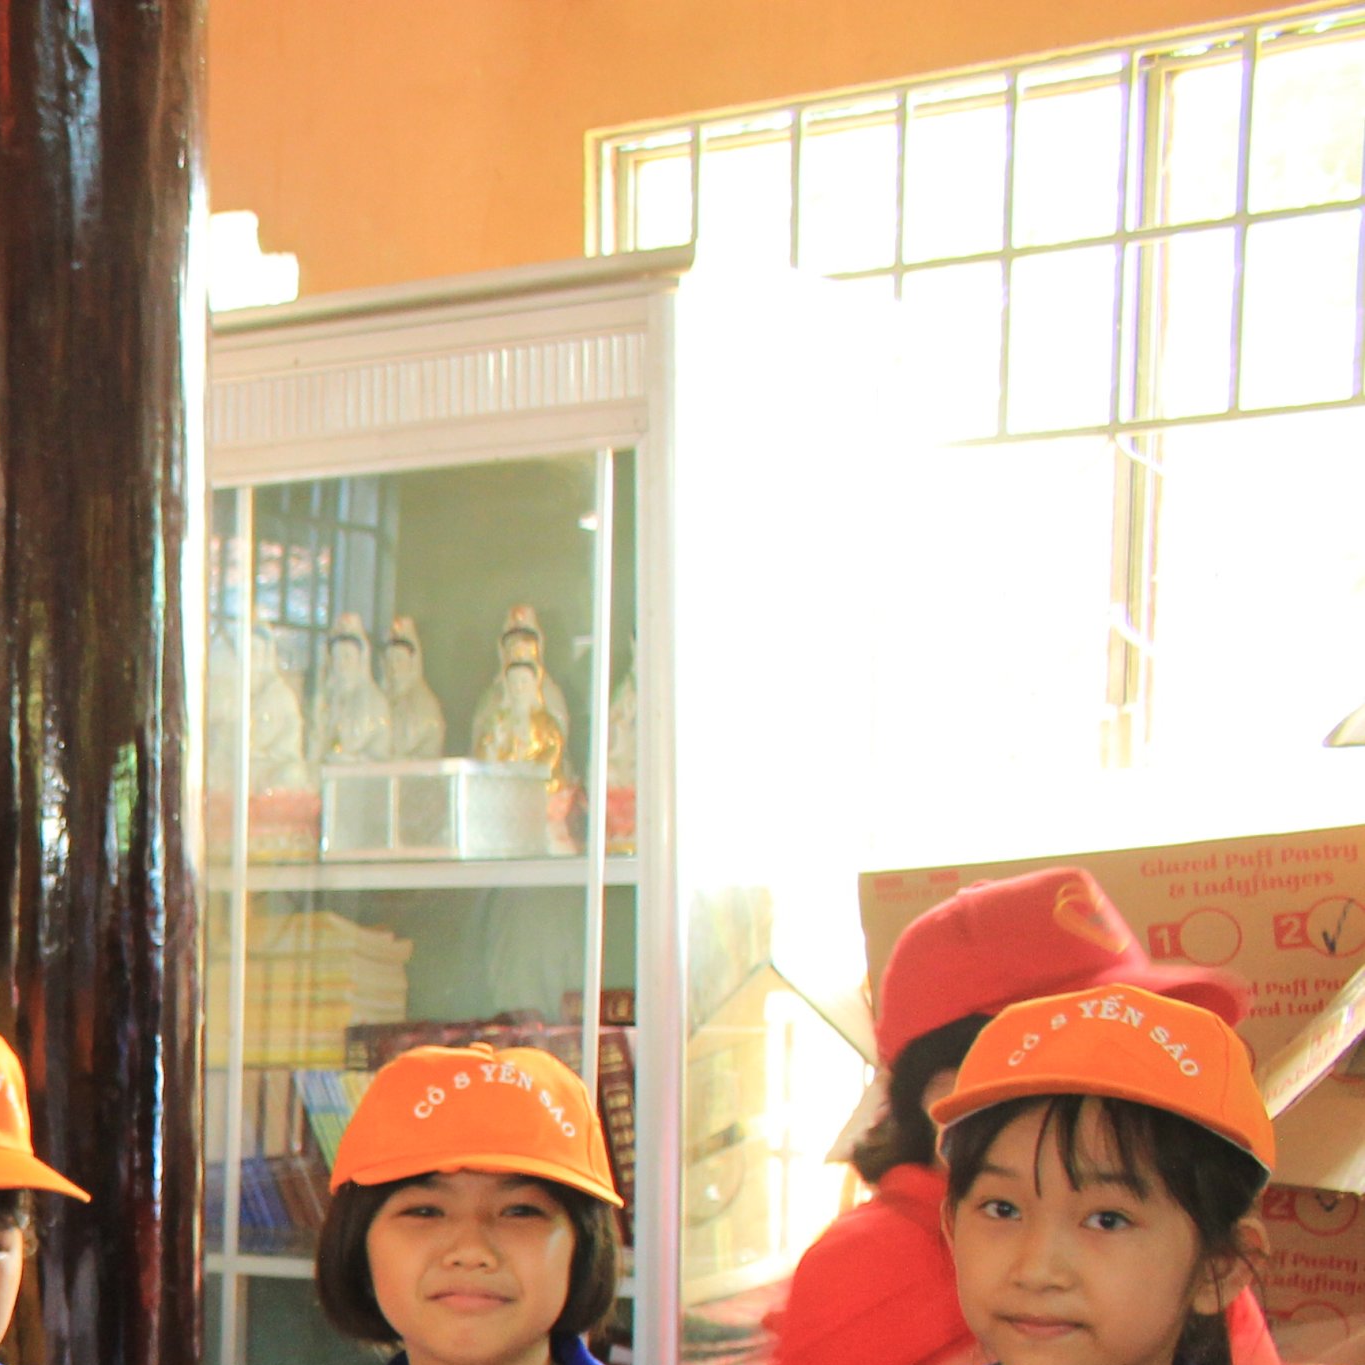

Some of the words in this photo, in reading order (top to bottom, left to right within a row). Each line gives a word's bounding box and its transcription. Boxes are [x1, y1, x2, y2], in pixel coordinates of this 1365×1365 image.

[1225, 846, 1273, 870] Puff
[1281, 843, 1359, 864] Pastry
[1078, 994, 1145, 1028] YẾN
